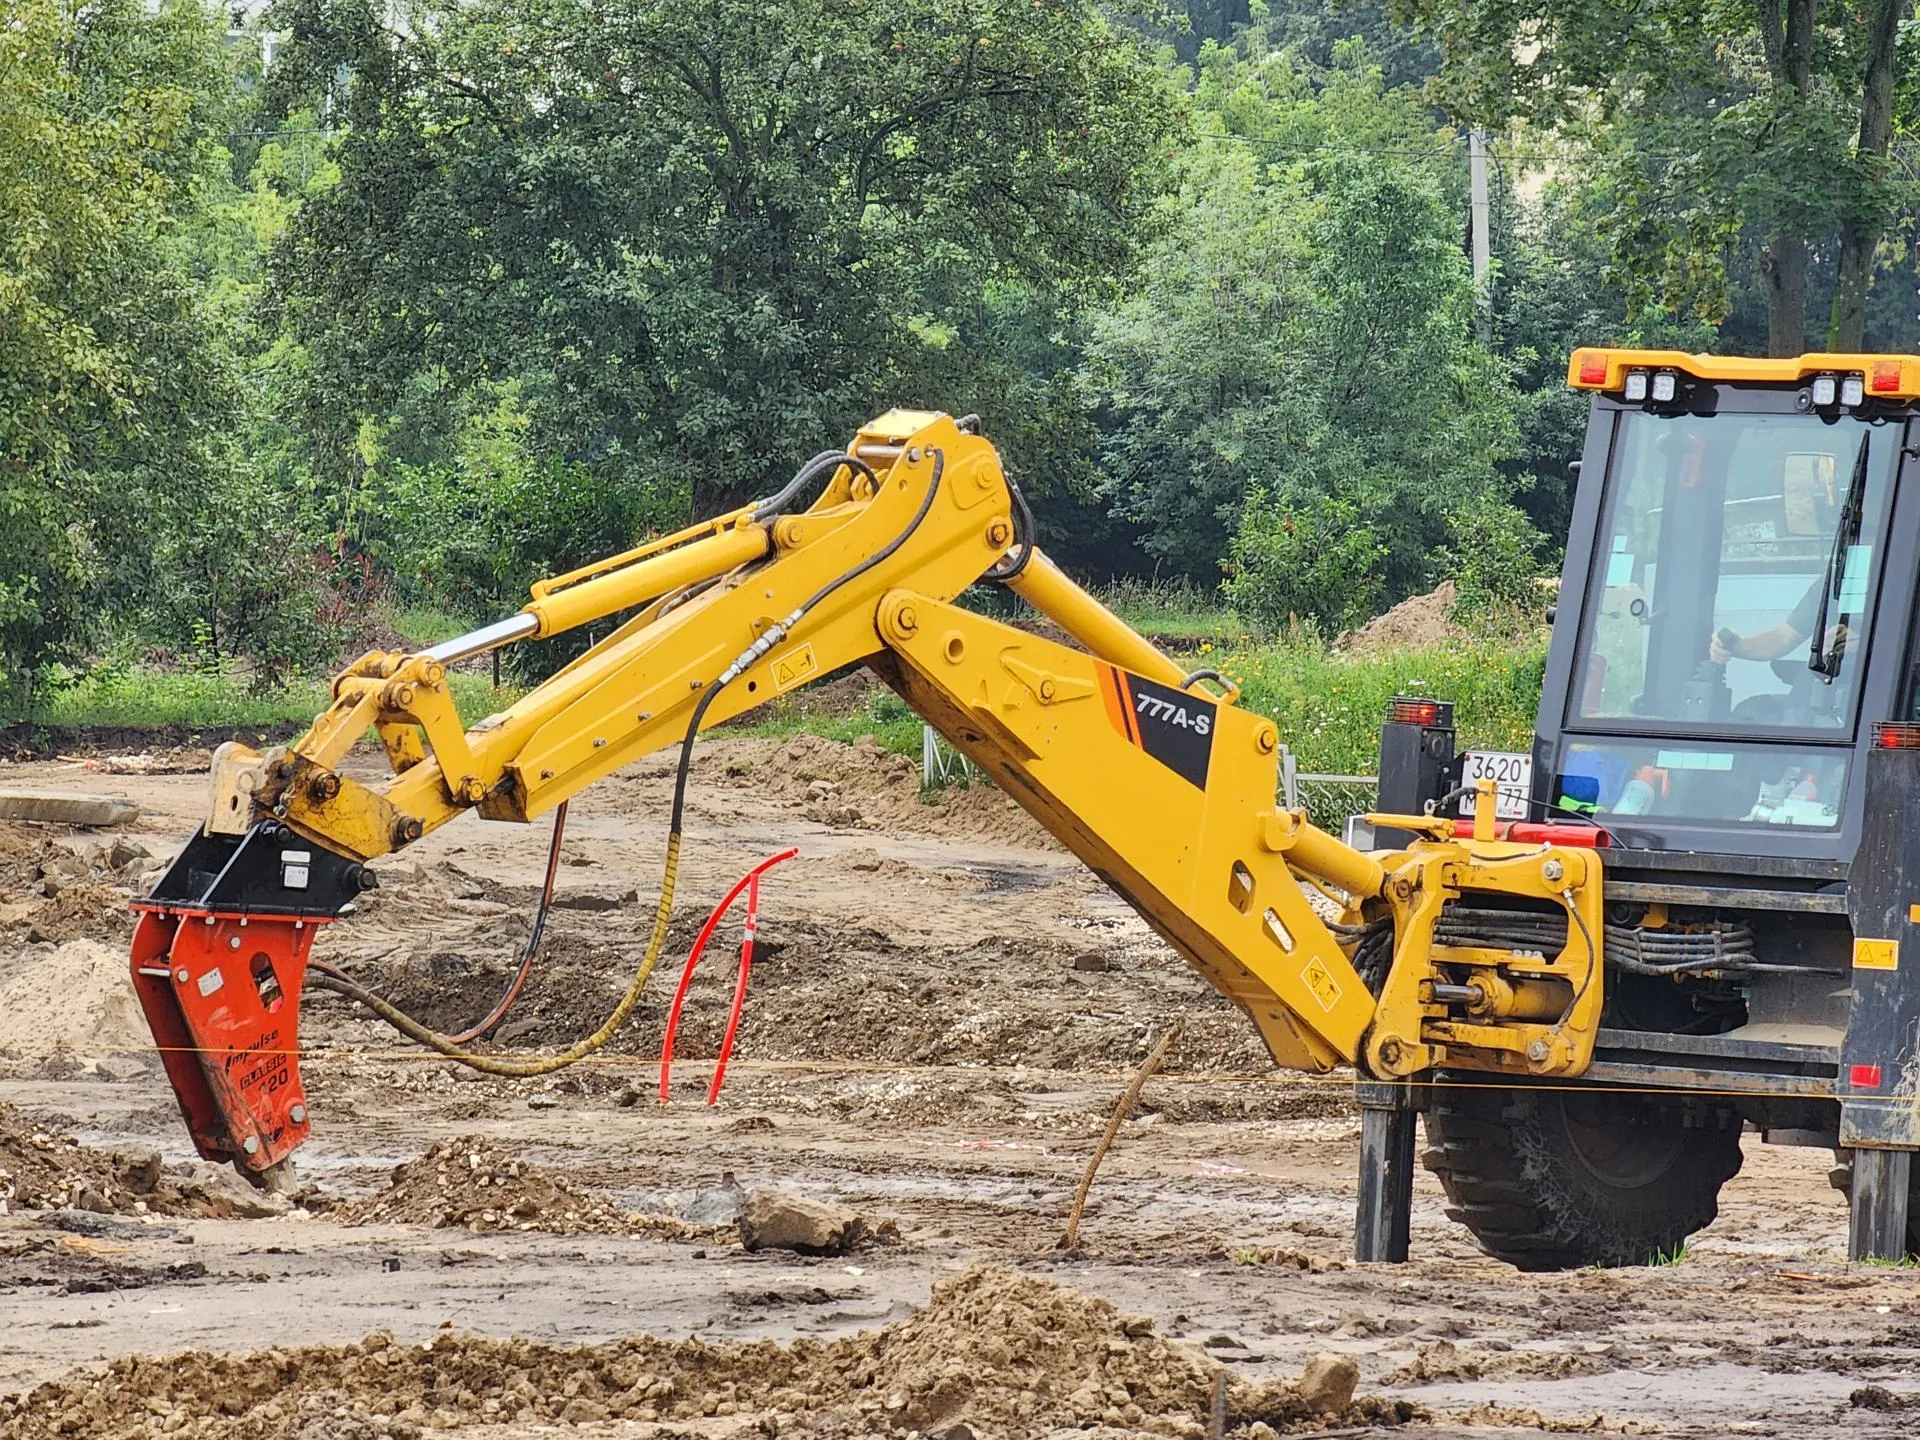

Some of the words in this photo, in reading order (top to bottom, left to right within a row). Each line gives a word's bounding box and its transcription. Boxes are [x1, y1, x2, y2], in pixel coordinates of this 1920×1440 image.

[1136, 693, 1210, 735] 777A-S
[1472, 755, 1522, 782] 3620
[1504, 787, 1523, 808] 77
[1497, 806, 1513, 816] RUS
